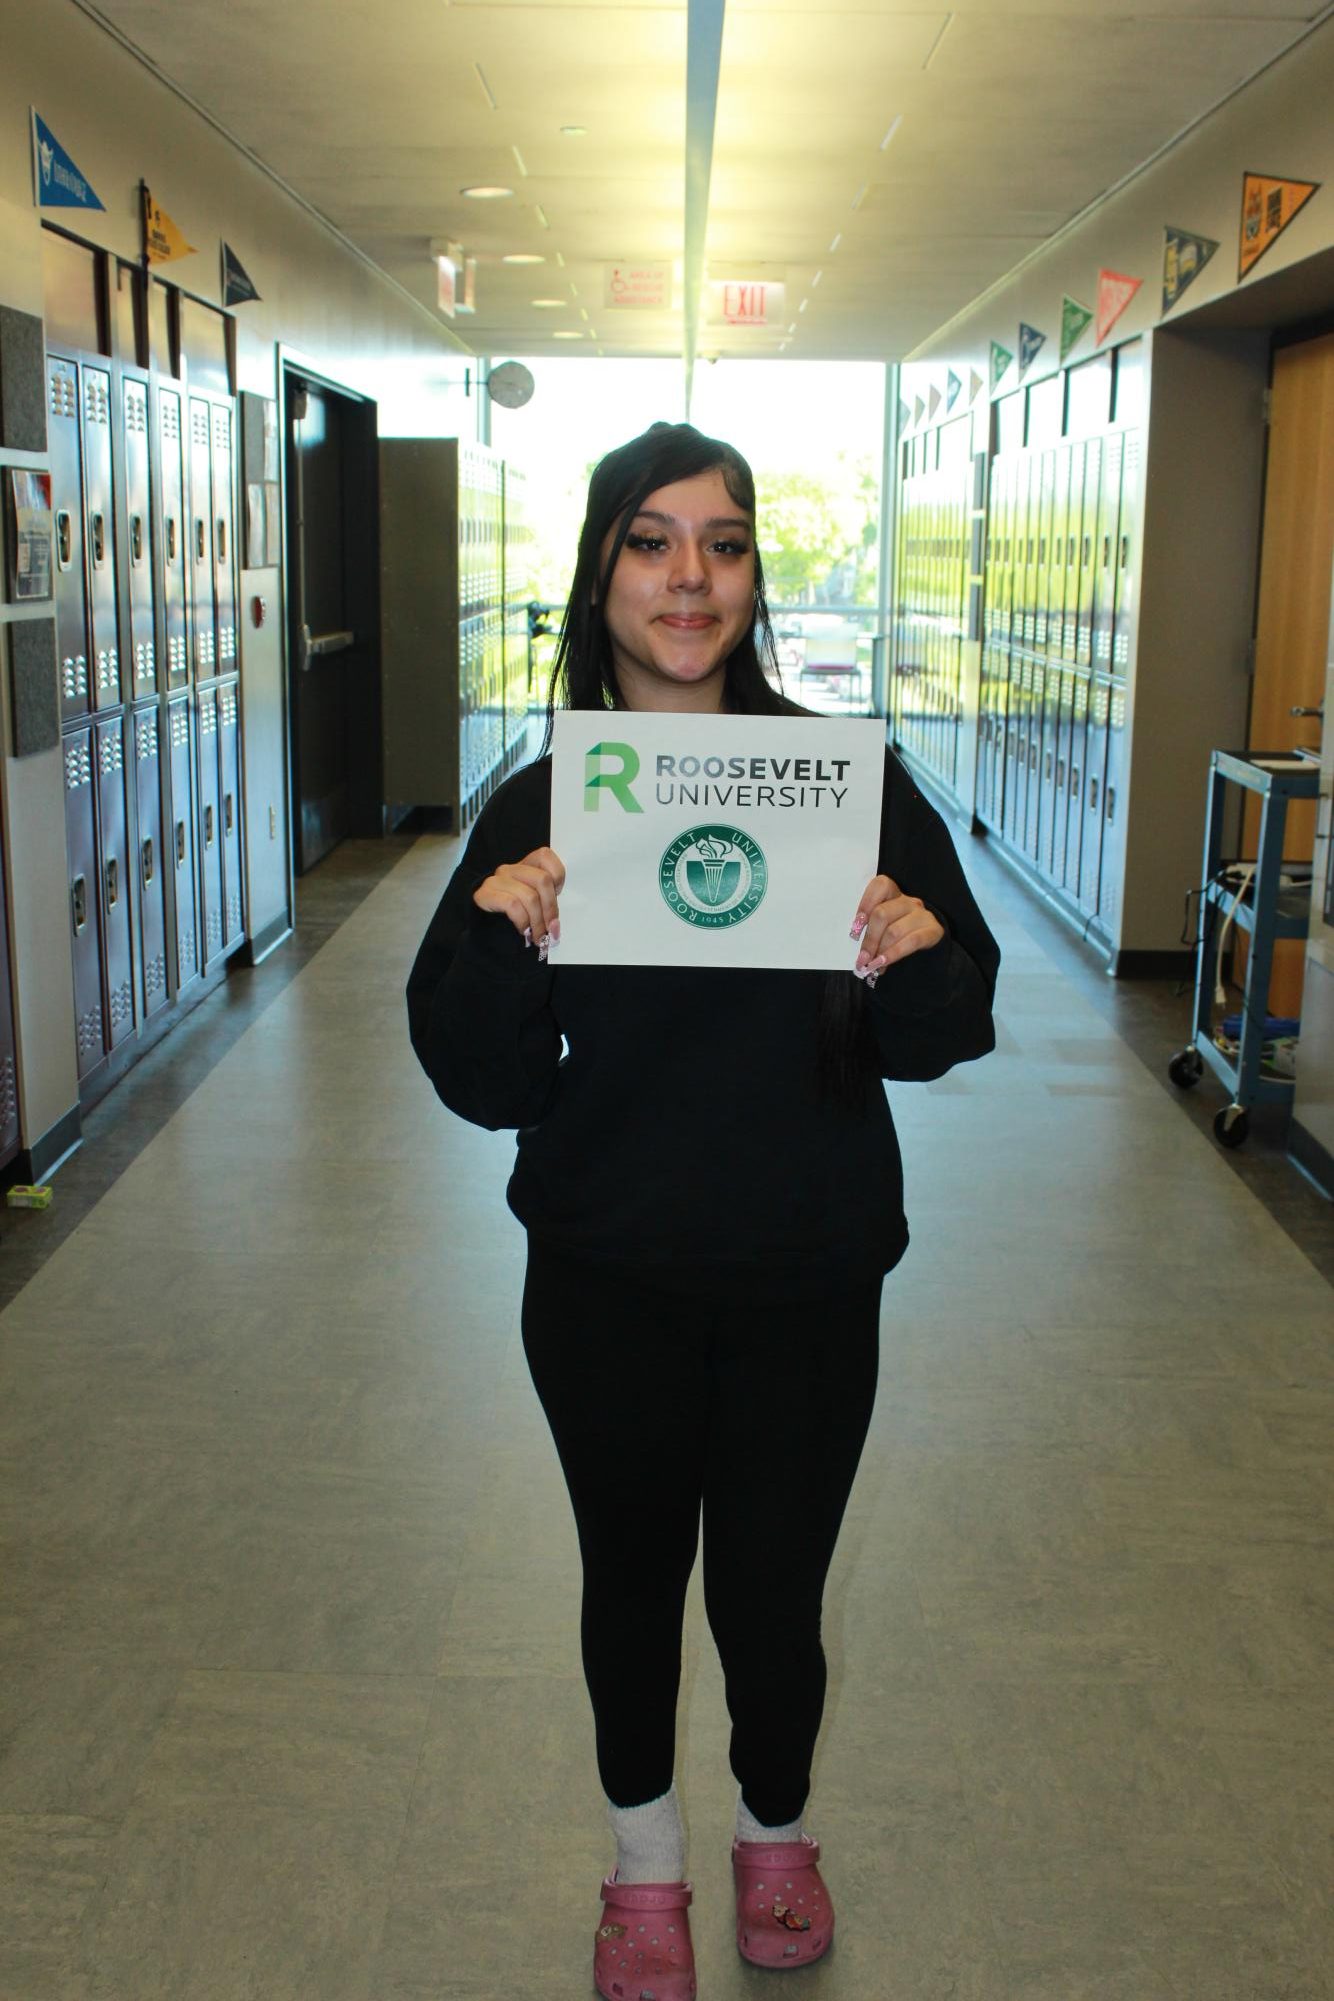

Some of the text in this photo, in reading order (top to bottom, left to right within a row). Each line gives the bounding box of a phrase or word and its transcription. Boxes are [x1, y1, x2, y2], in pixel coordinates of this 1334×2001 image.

[724, 285, 766, 317] EXIT
[656, 754, 851, 781] ROOSEVELT
[656, 783, 848, 809] UNIVERSITY
[663, 832, 698, 921] ROOSEVELT
[729, 832, 764, 923] UNIVERSITY
